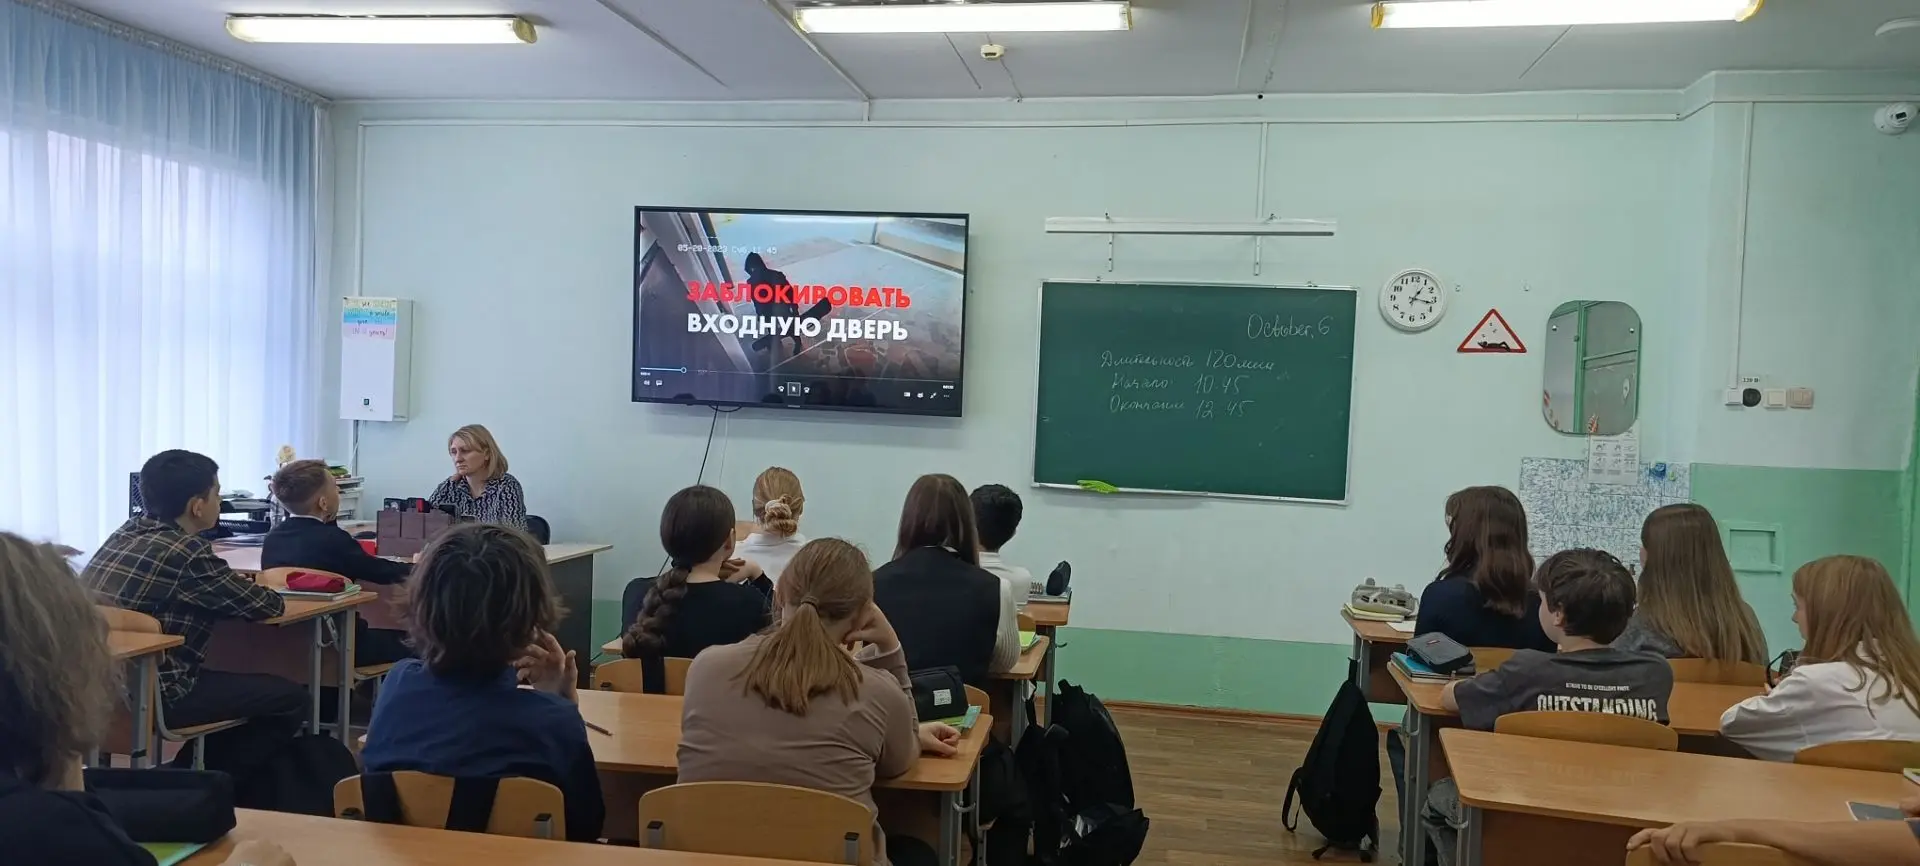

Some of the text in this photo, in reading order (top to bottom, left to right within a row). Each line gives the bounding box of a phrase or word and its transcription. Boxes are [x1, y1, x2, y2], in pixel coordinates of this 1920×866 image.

[686, 281, 911, 308] ЗАБЛОКИРОВАТЬ
[687, 312, 909, 341] ВХОДНУЮ ДВЕРЬ
[1318, 314, 1334, 336] 6
